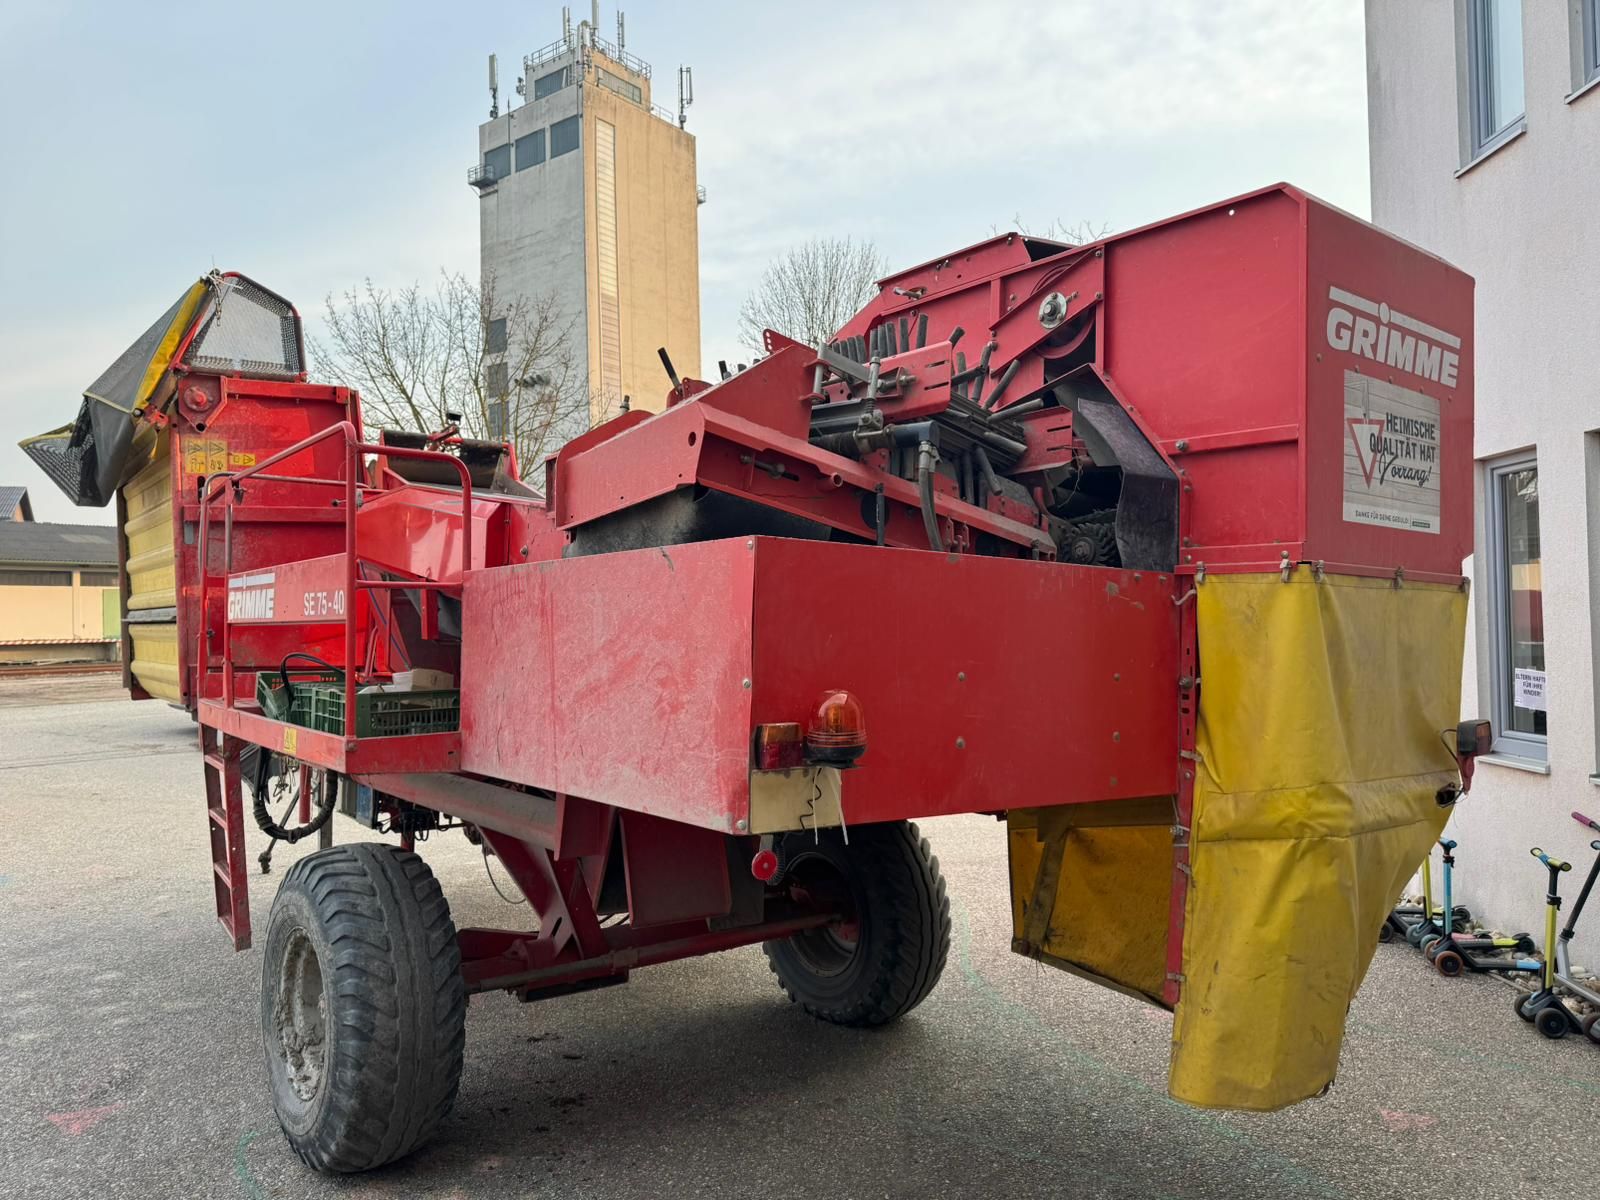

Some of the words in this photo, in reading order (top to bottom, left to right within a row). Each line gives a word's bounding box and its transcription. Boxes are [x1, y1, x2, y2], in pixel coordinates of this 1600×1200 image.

[1326, 302, 1460, 389] GRIMME
[1386, 412, 1436, 441] HEIMISCHE
[1369, 432, 1417, 460] QUALITÄT
[1419, 443, 1436, 463] HAT
[1379, 453, 1432, 488] Vorrang!
[227, 588, 275, 619] GRIMME
[303, 592, 316, 616] SE
[1515, 673, 1531, 681] ELTERN
